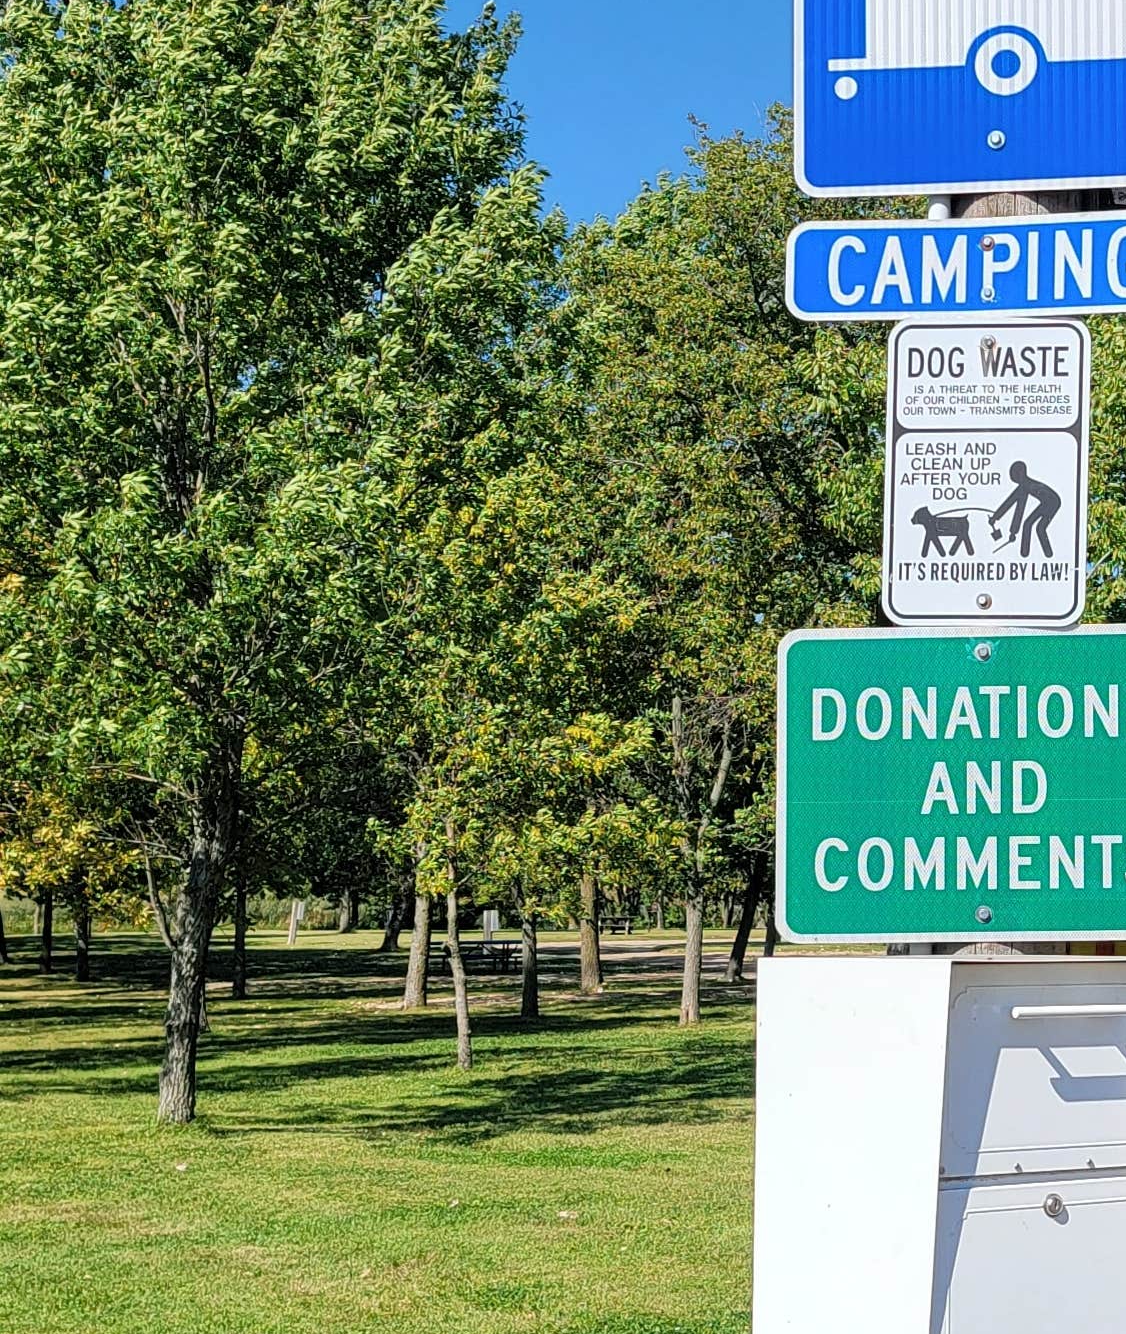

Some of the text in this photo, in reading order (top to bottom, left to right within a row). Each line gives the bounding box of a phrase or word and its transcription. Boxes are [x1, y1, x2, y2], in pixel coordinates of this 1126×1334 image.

[907, 346, 1069, 378] DOG WASTE
[914, 384, 1061, 394] IS A THREAT TO THE HEALTH
[905, 396, 919, 405] OF
[923, 396, 945, 405] OUR
[949, 396, 1000, 404] CHILDREN
[1014, 395, 1070, 404] DEGRADES
[903, 407, 924, 415] OUR
[928, 406, 956, 415] TOWN
[970, 406, 1025, 415] TRANSMITS
[1029, 406, 1072, 415] DISEASE
[905, 443, 997, 456] LEASH AND
[911, 457, 991, 471] CLEAN UP
[900, 472, 1001, 485] AFTER YOUR
[932, 487, 967, 500] DOG
[899, 562, 1069, 583] IT'S REQUIRED BY LAW!
[920, 760, 1048, 815] AND
